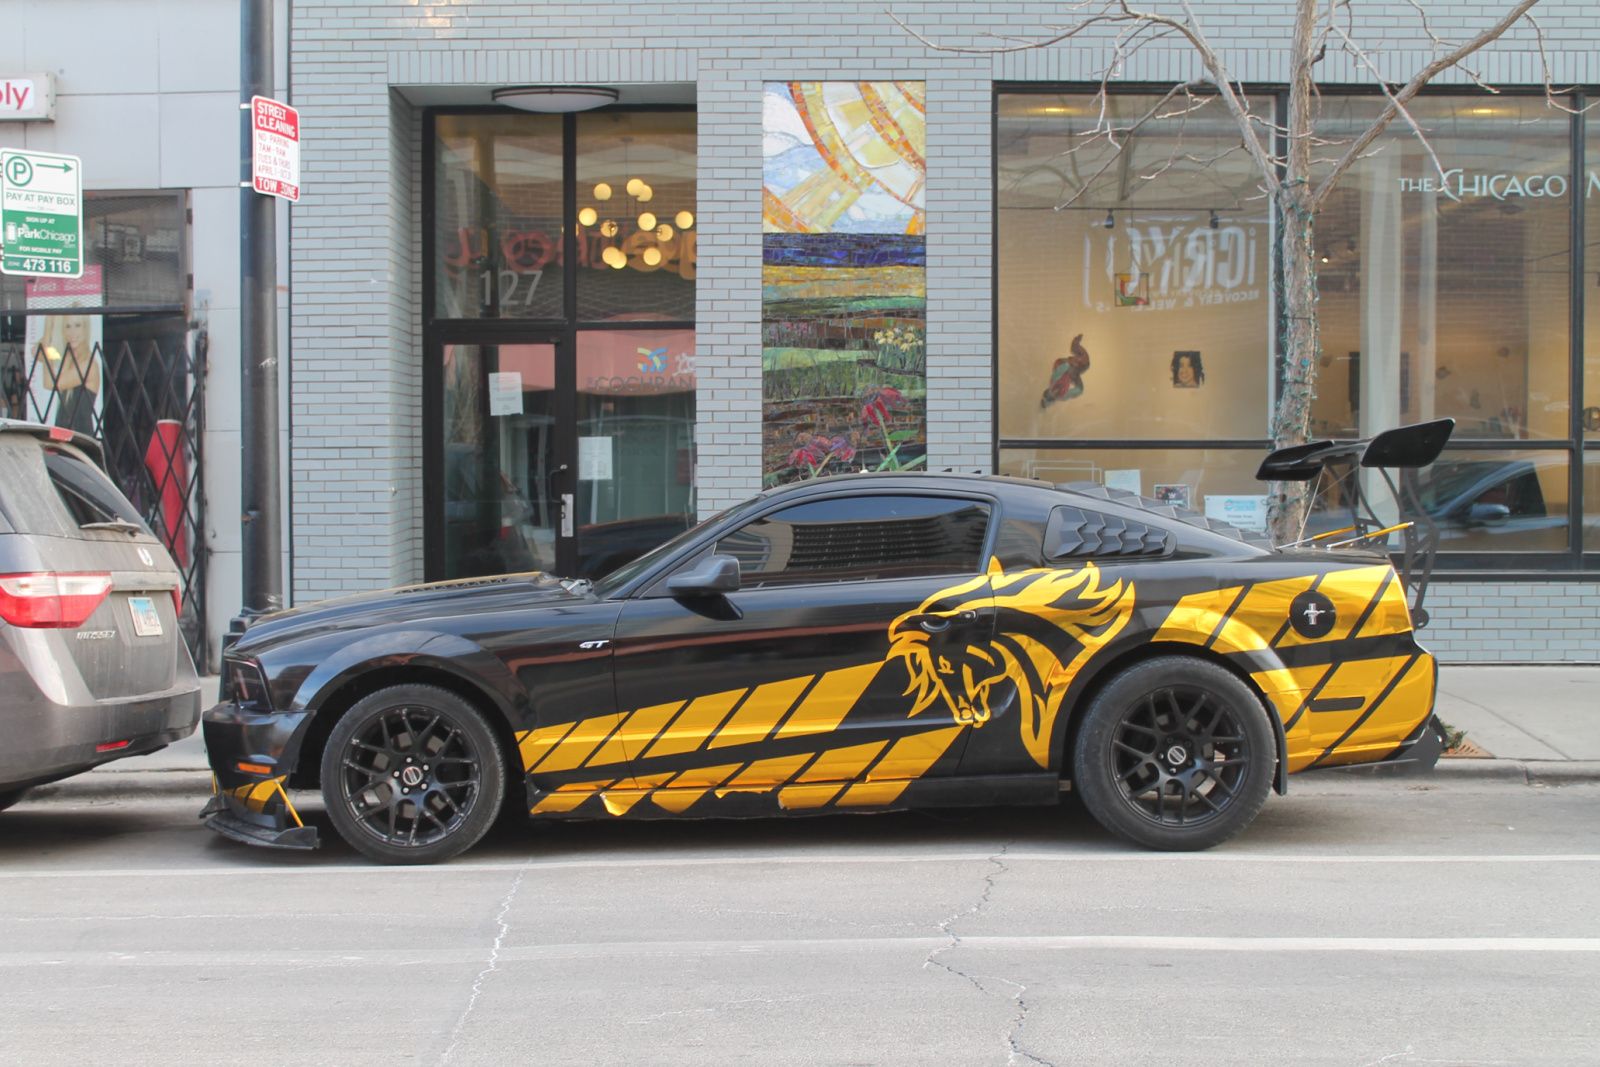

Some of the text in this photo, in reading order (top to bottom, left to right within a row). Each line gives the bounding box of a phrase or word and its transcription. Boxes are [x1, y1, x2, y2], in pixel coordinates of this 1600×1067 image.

[257, 102, 286, 120] STREET
[257, 115, 295, 138] CLEANING
[13, 161, 26, 180] P
[258, 177, 297, 198] TOW ZONE
[1398, 177, 1434, 192] THE
[1441, 168, 1568, 203] CHICAGO
[6, 192, 75, 206] PAY AT PAY BOX
[17, 227, 76, 244] ParkChicago
[23, 258, 46, 272] 473
[49, 260, 71, 273] 116
[480, 270, 543, 306] 127
[579, 640, 609, 649] GT
